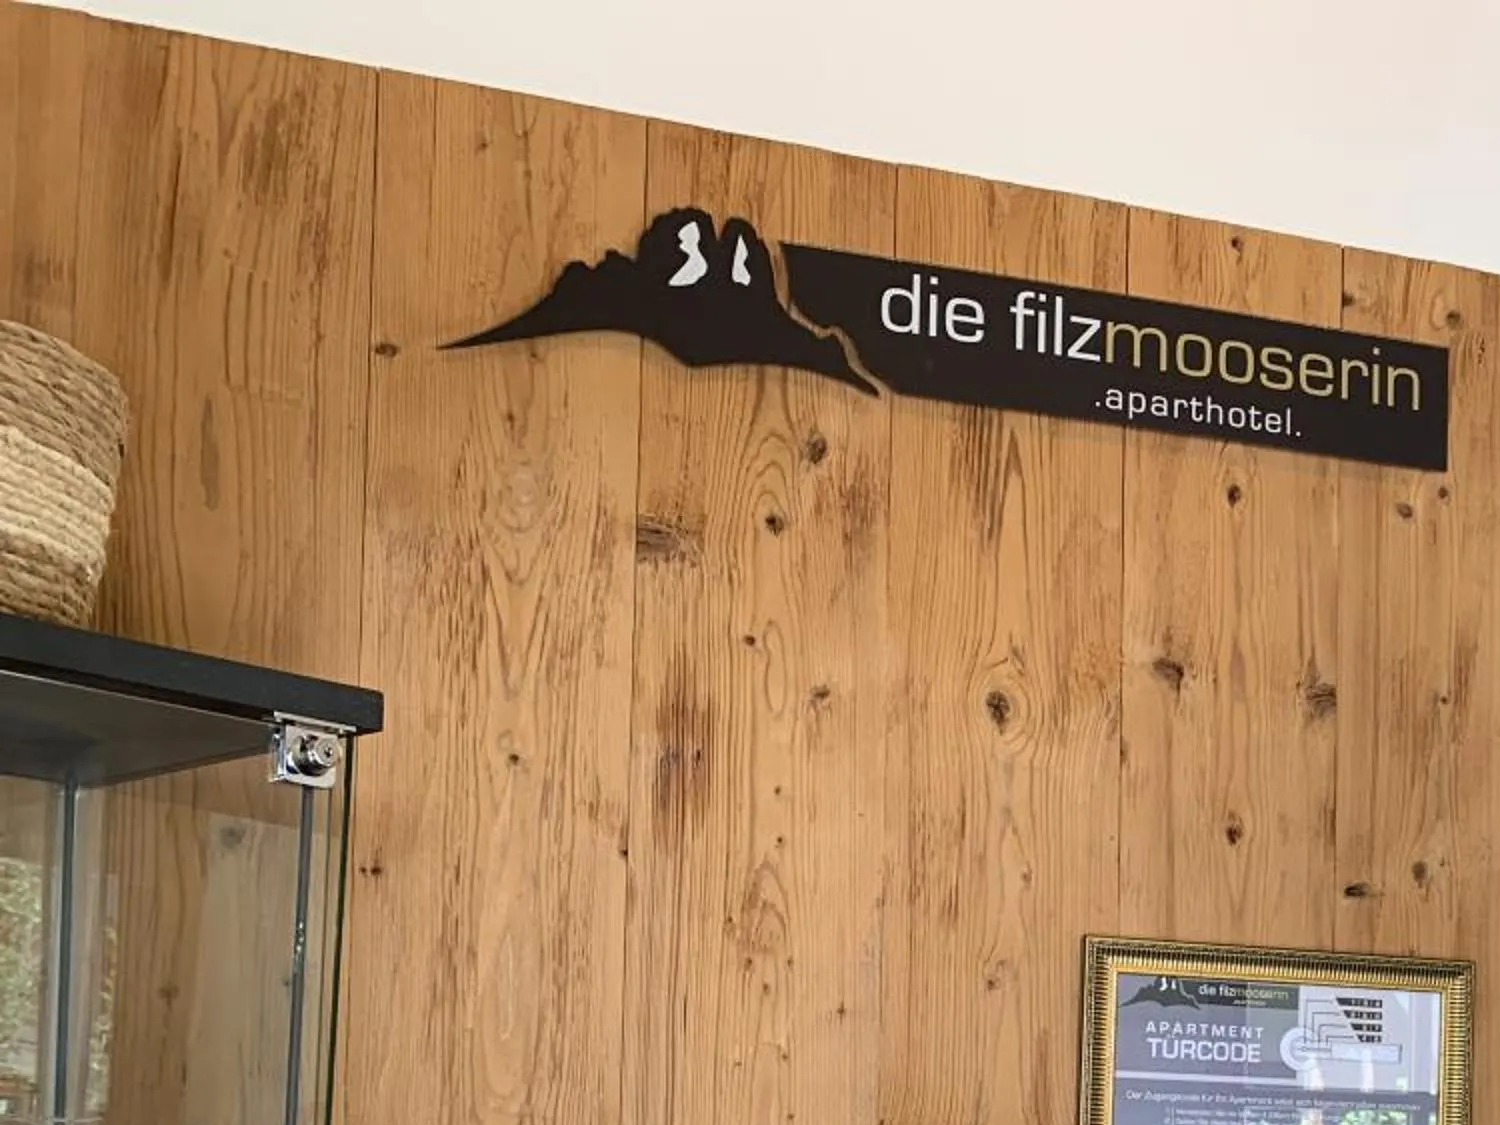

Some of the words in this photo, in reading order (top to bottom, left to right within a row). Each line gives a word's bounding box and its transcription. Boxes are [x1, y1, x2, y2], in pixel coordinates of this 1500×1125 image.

[879, 273, 986, 343] die
[1008, 291, 1421, 411] filzmooserin
[1145, 1020, 1265, 1040] APARTMENT
[1146, 1032, 1262, 1063] TÜRCODE
